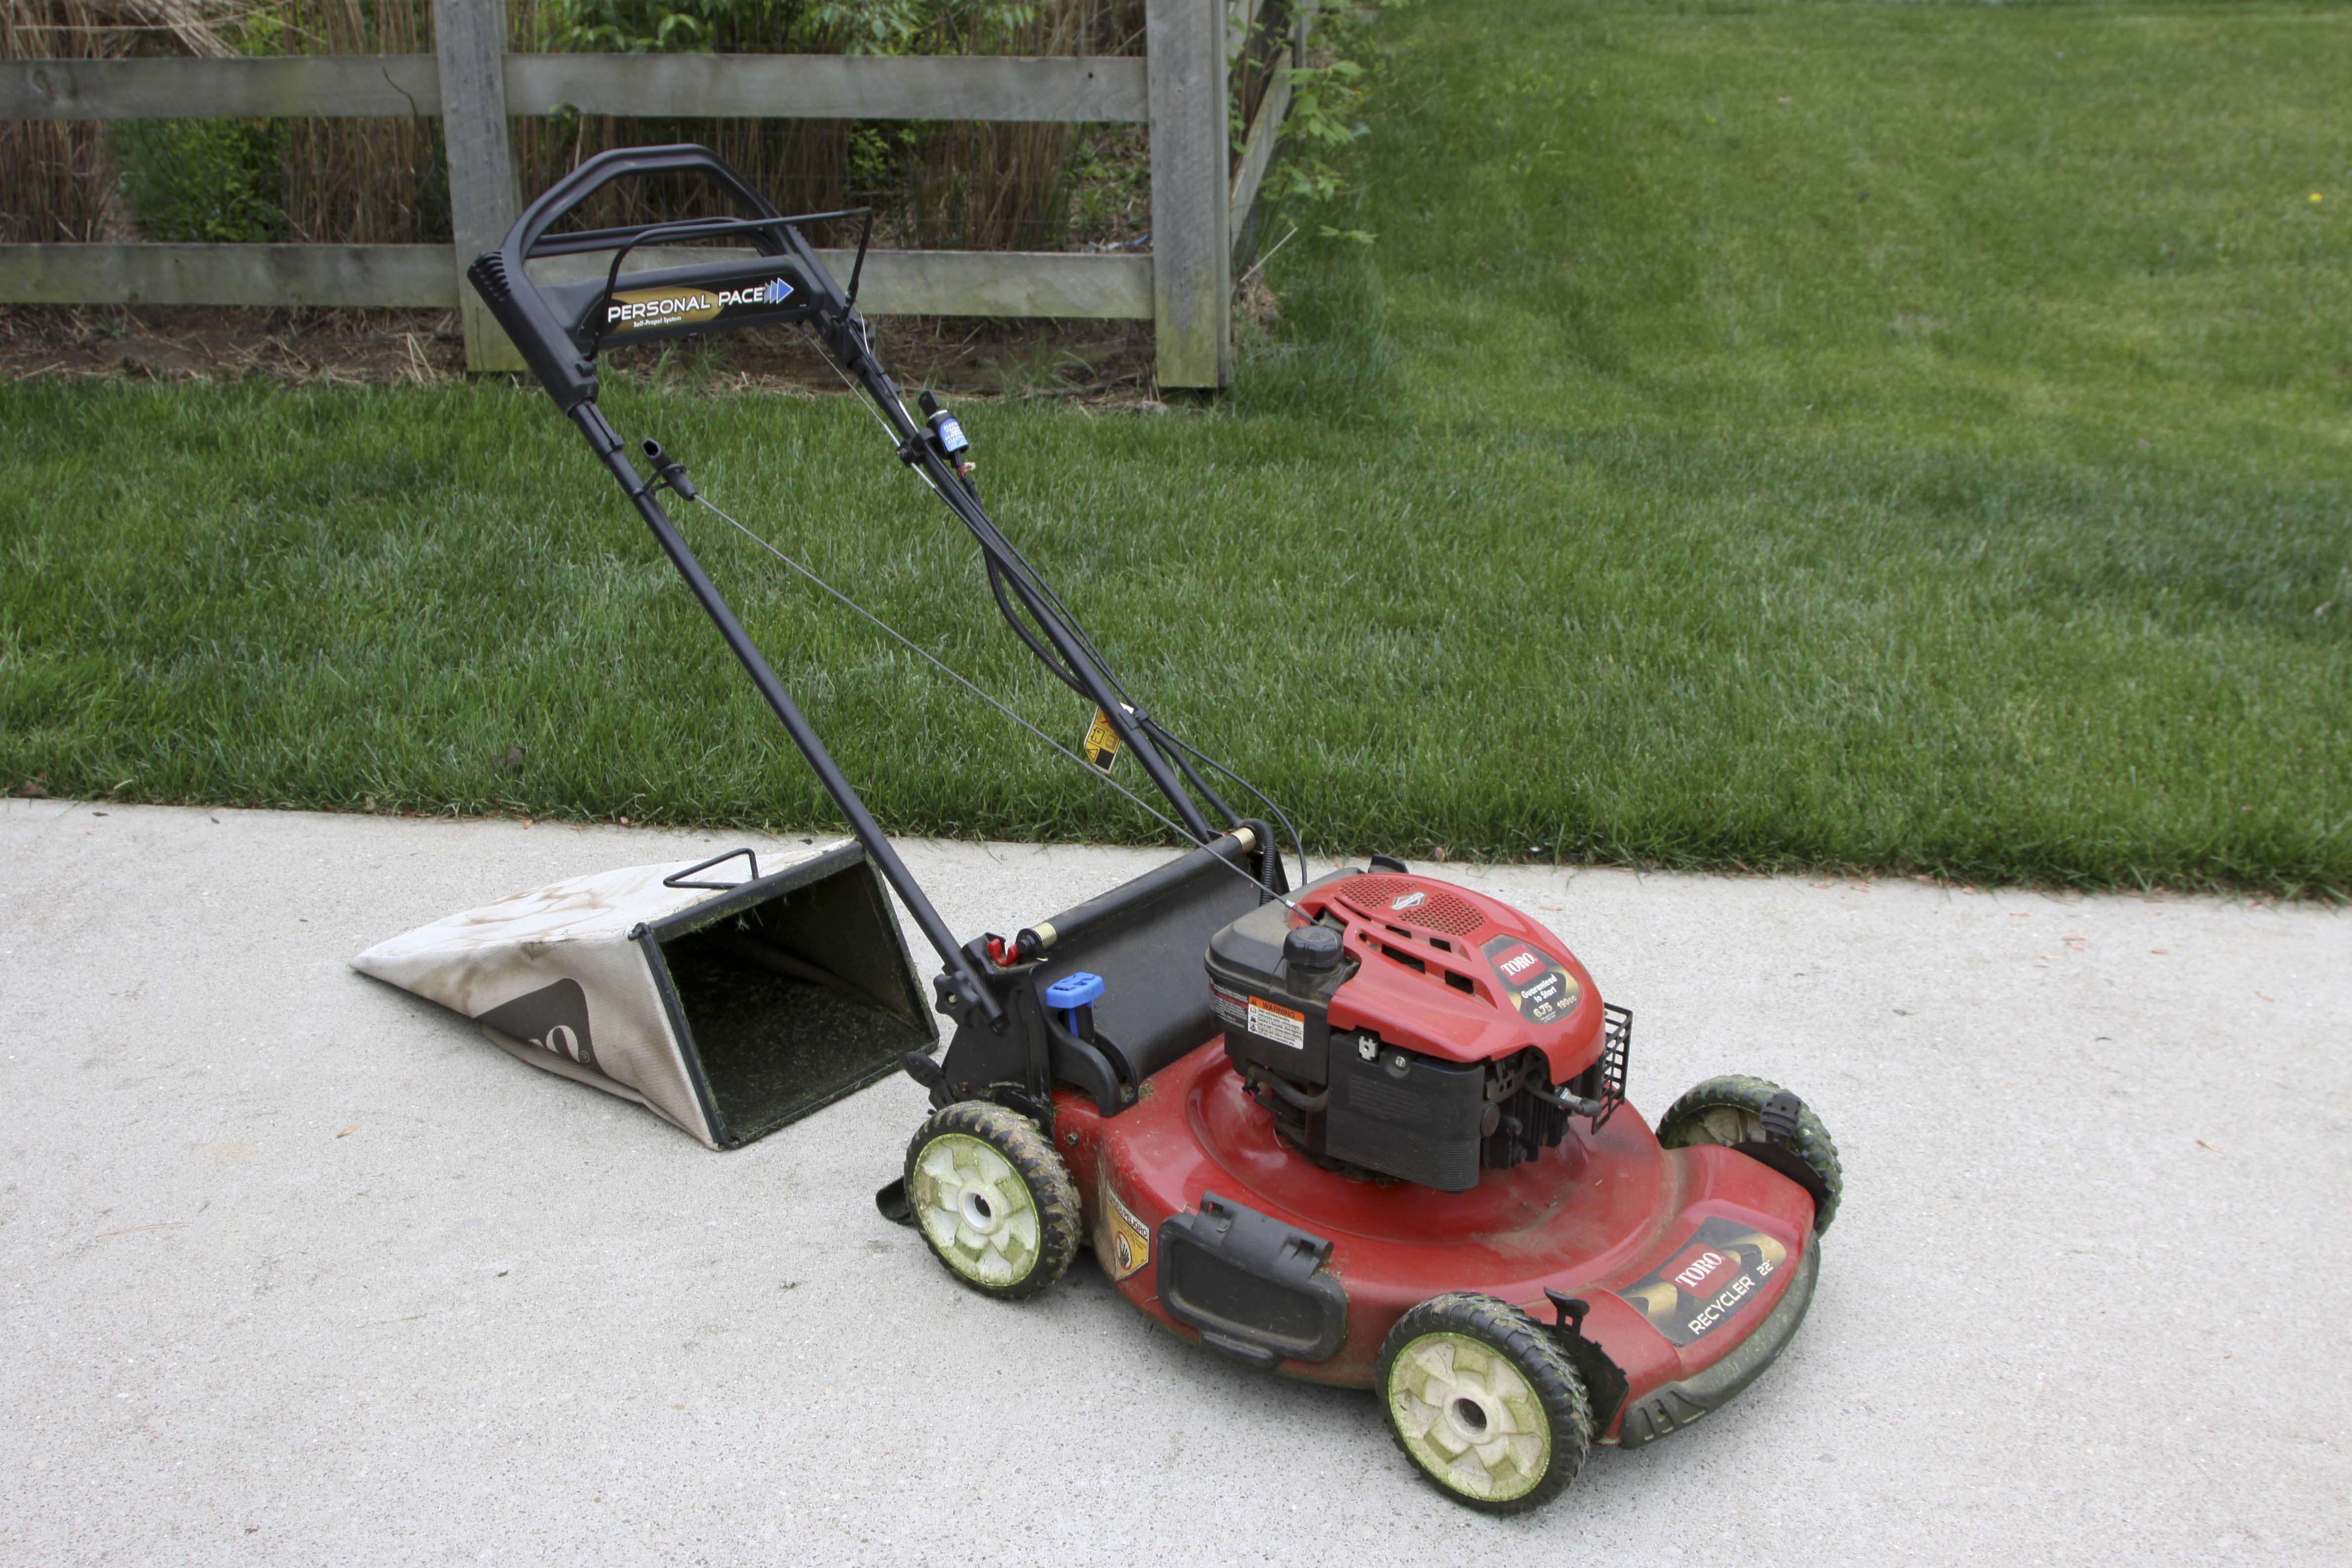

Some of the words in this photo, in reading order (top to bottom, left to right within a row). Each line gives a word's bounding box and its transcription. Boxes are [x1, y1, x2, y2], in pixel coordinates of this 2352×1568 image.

[608, 295, 710, 322] PERSONAL
[718, 287, 764, 306] PACE
[634, 317, 662, 327] Self-Propel
[663, 315, 681, 324] System
[1500, 952, 1535, 976] TORO
[1521, 974, 1558, 999] Guaranteed
[1533, 995, 1543, 1003] to
[1541, 985, 1557, 1000] Start
[1263, 1001, 1295, 1019] WARNING
[1557, 995, 1577, 1010] 190cc
[1675, 1252, 1722, 1287] TORO
[1687, 1275, 1755, 1335] RECYCLER
